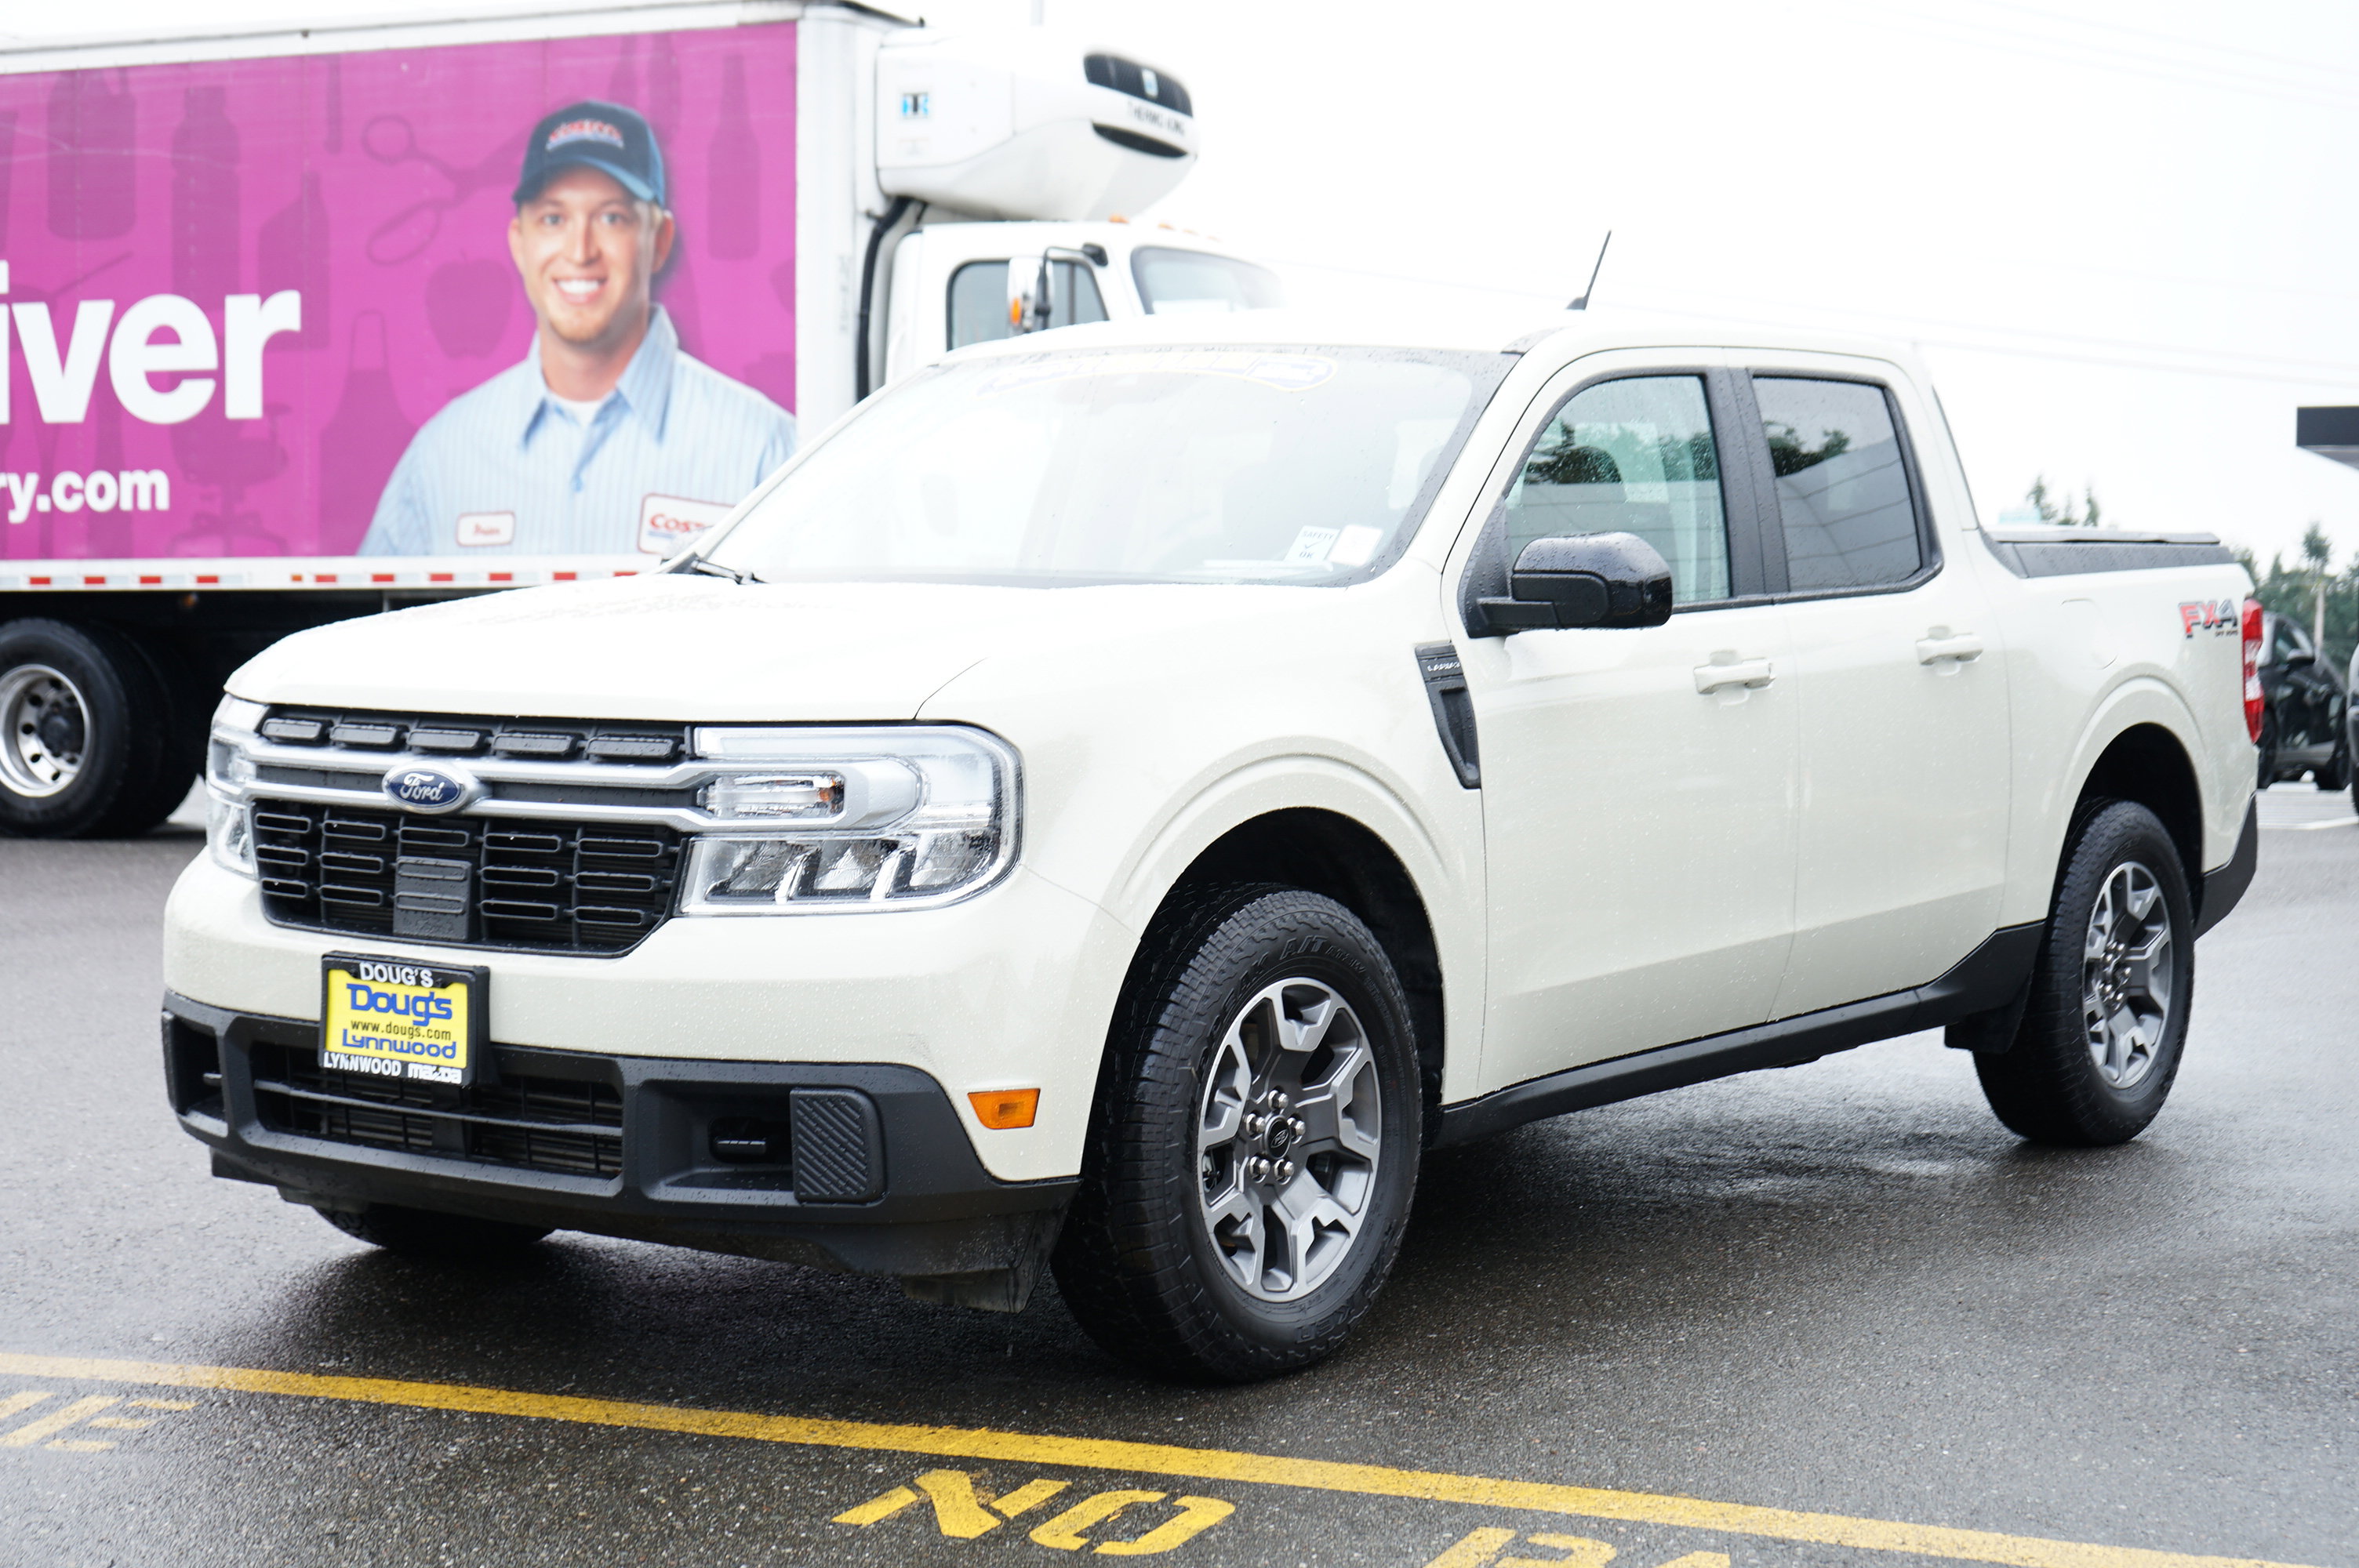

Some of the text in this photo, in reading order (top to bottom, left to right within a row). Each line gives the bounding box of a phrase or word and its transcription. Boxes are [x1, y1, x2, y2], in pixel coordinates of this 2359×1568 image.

[0, 260, 301, 424] ver
[0, 469, 170, 524] y.com
[1303, 531, 1335, 540] SAFETY
[1299, 550, 1314, 559] OK
[2178, 599, 2238, 639] FX4
[399, 772, 445, 801] Ford
[358, 961, 434, 989] DOUG'S
[341, 1028, 456, 1060] Lynnwood
[351, 1019, 452, 1040] www.dougs.com
[323, 1051, 402, 1077] LYNNWOOD
[831, 1469, 1236, 1555] NO
